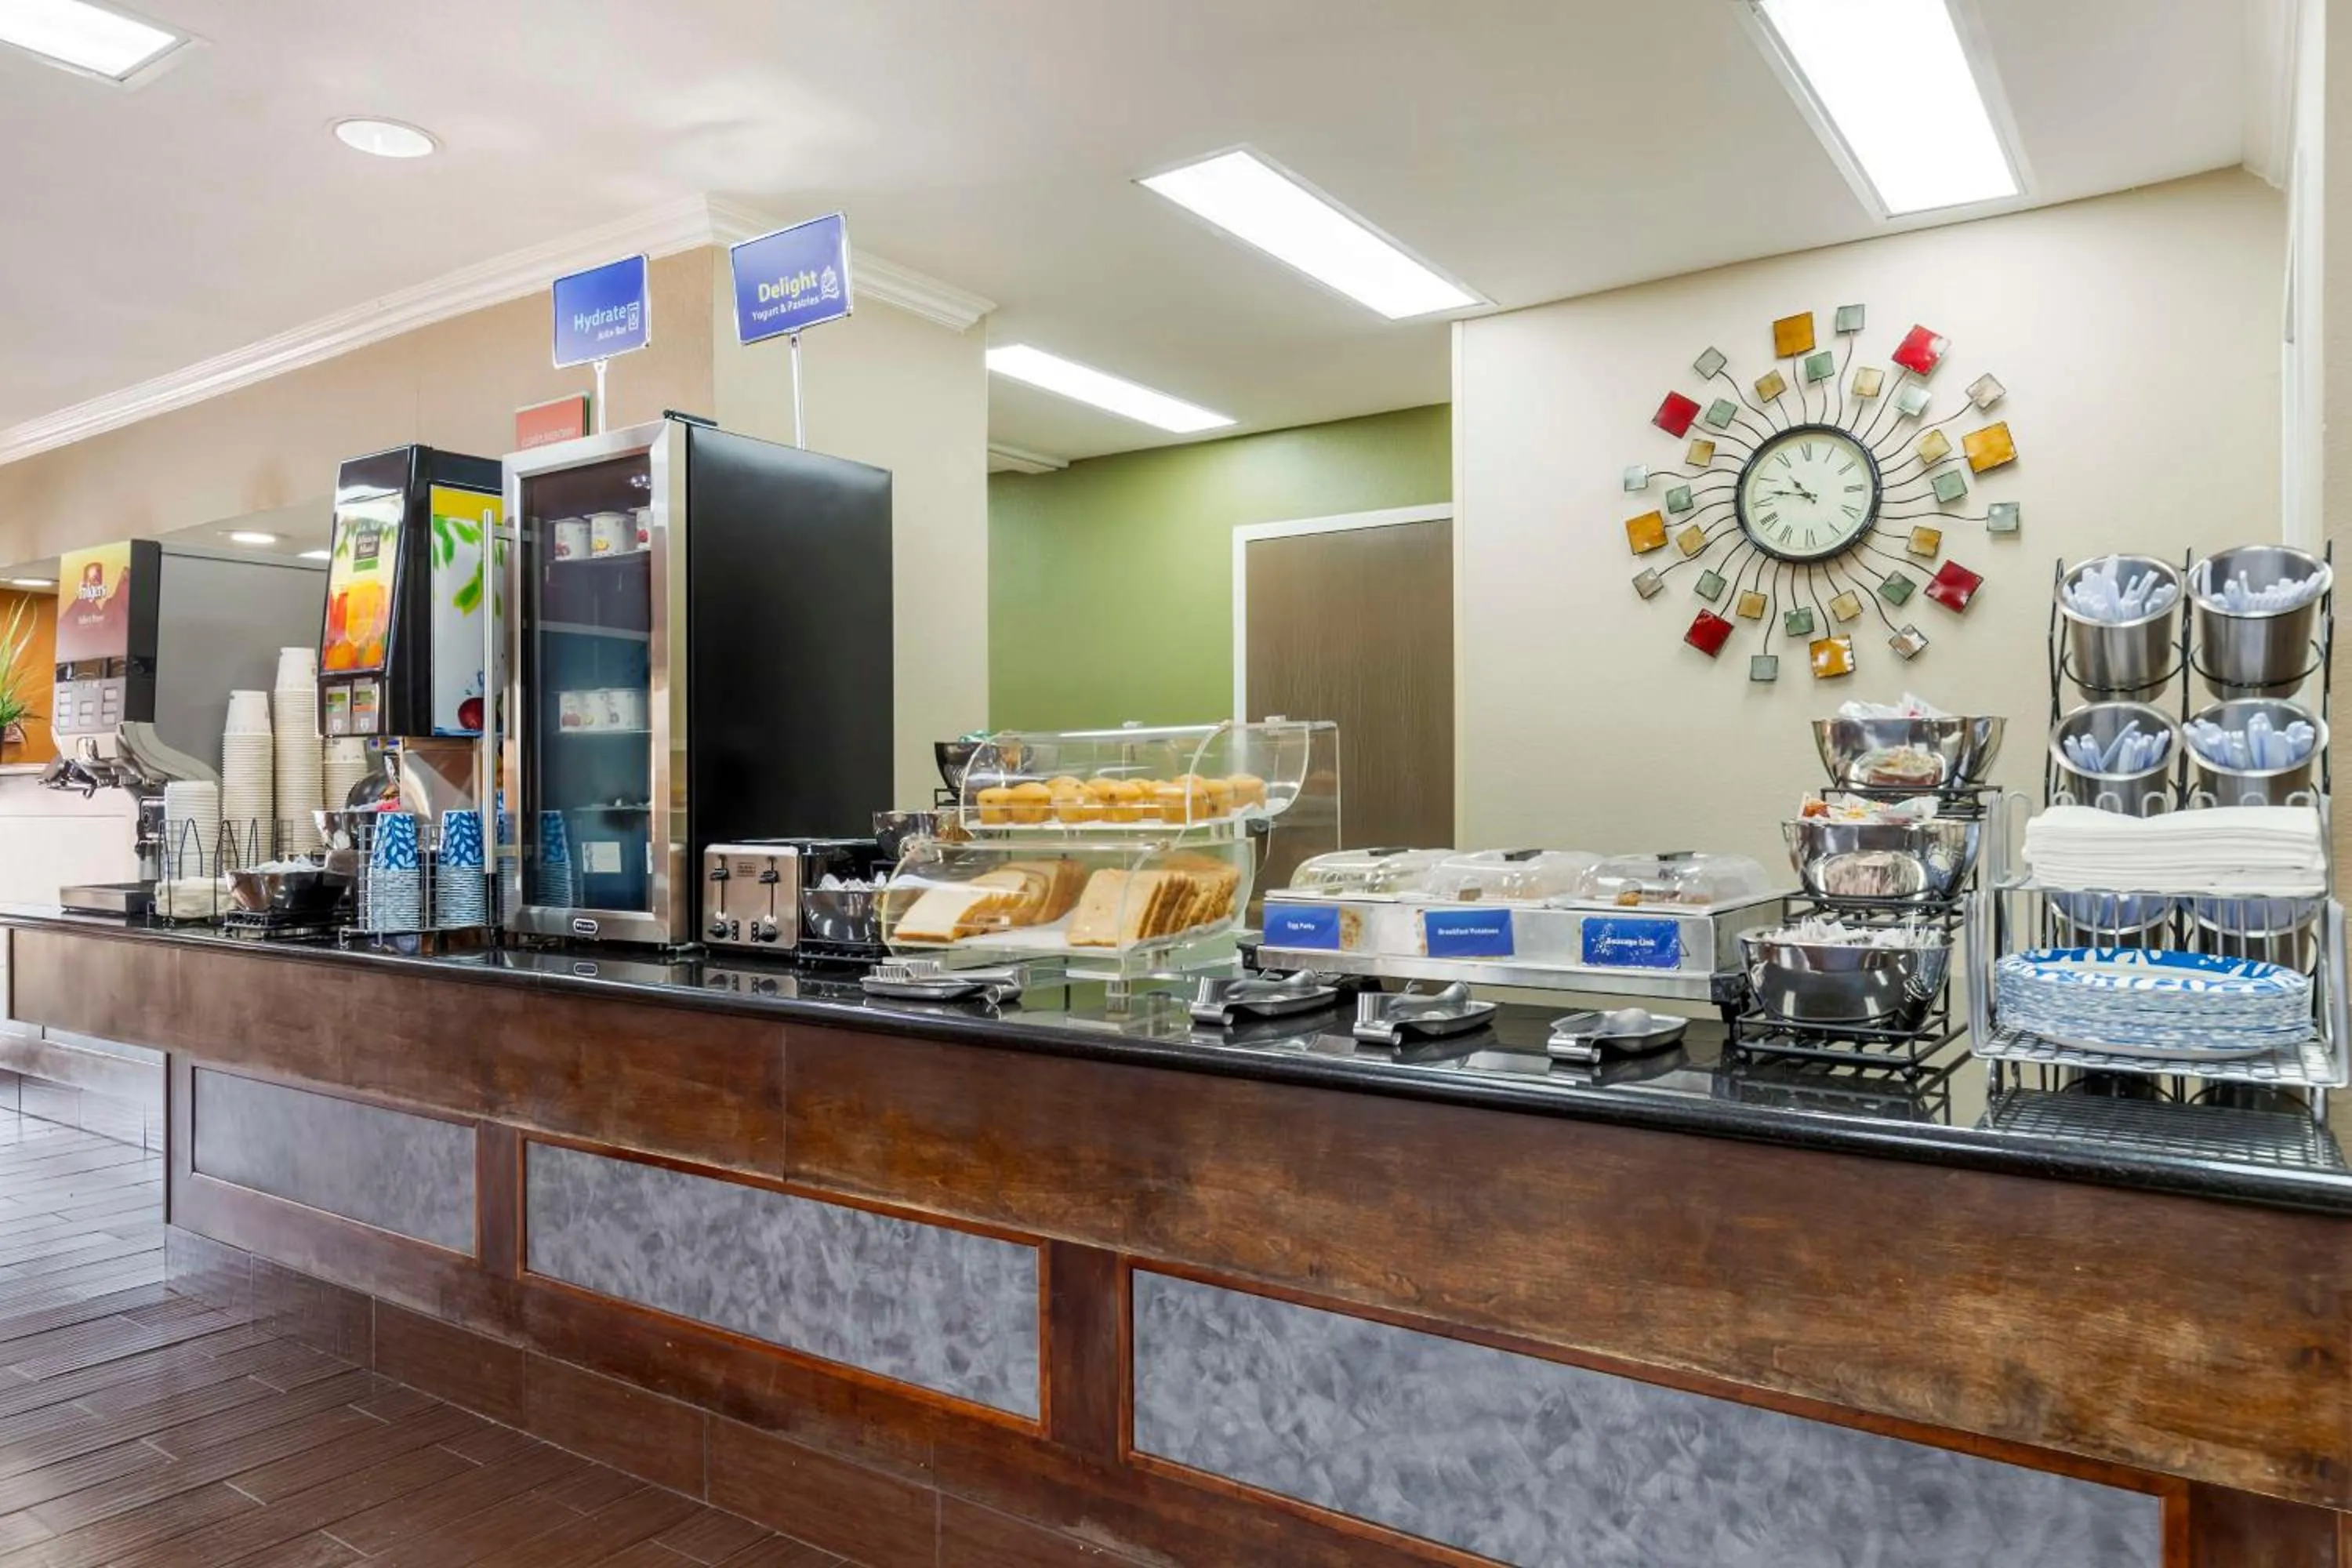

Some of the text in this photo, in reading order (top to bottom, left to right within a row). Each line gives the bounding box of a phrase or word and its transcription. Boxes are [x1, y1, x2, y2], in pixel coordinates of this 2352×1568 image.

[758, 270, 818, 303] Delight
[574, 305, 626, 334] Hydrate
[752, 306, 779, 321] Yogurt
[1287, 920, 1316, 931] Egg Patty
